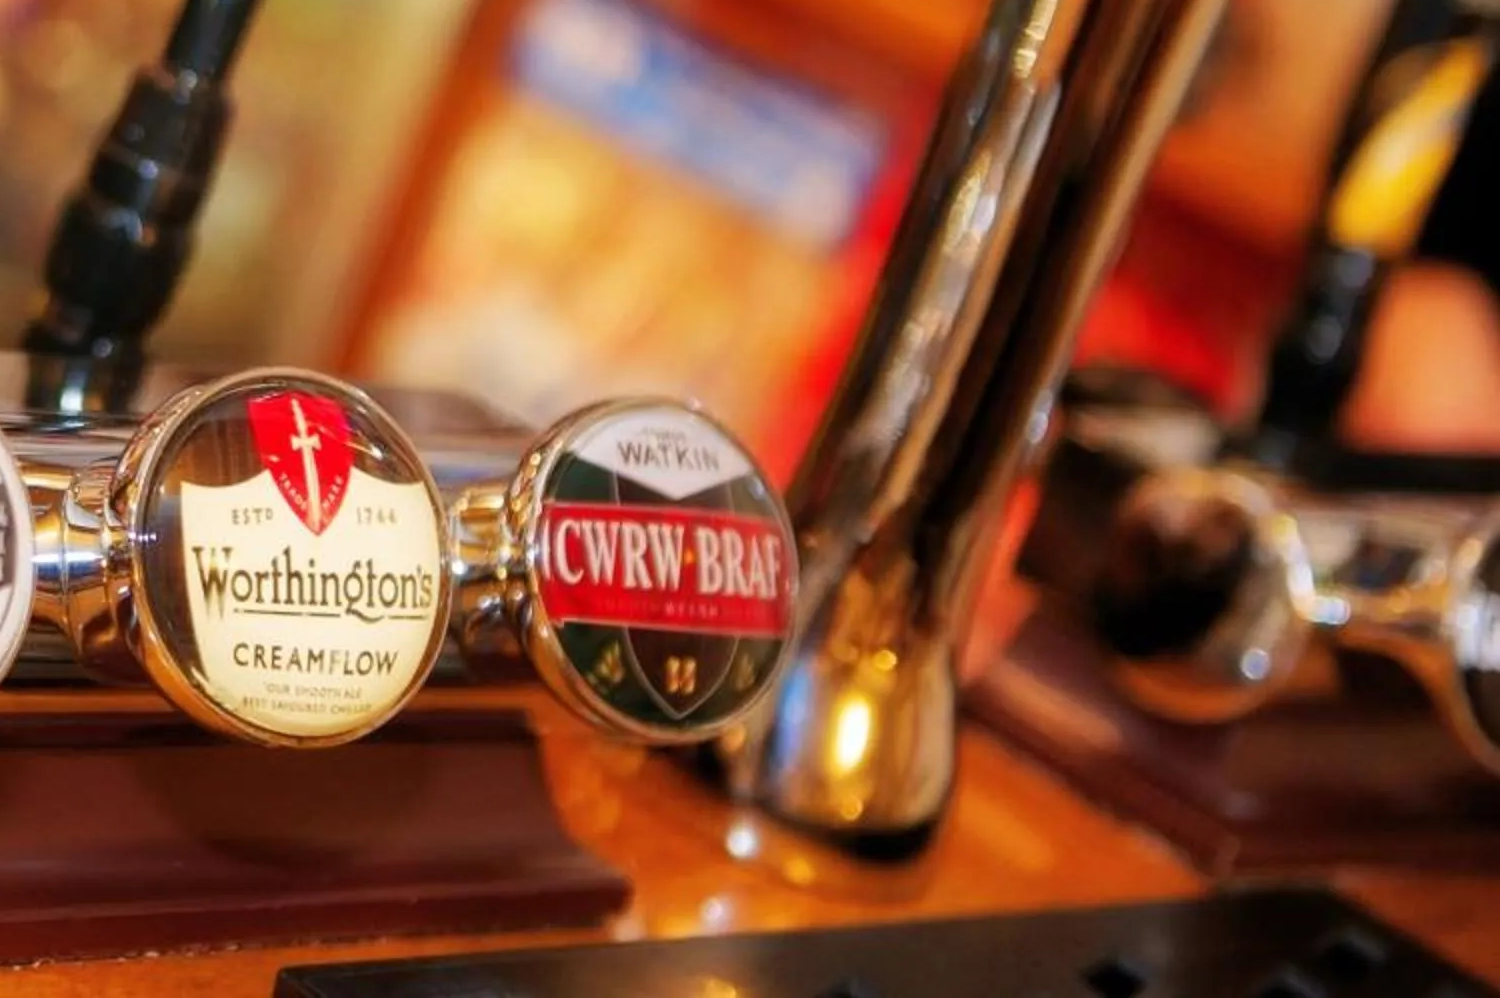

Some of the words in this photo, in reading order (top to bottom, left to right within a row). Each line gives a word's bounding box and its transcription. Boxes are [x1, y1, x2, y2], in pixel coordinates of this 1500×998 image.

[616, 439, 721, 472] WATKIN
[191, 545, 434, 623] Worthington's
[555, 517, 685, 593] CWRW
[695, 523, 782, 601] BRAF
[233, 642, 399, 676] CREAMFLOW
